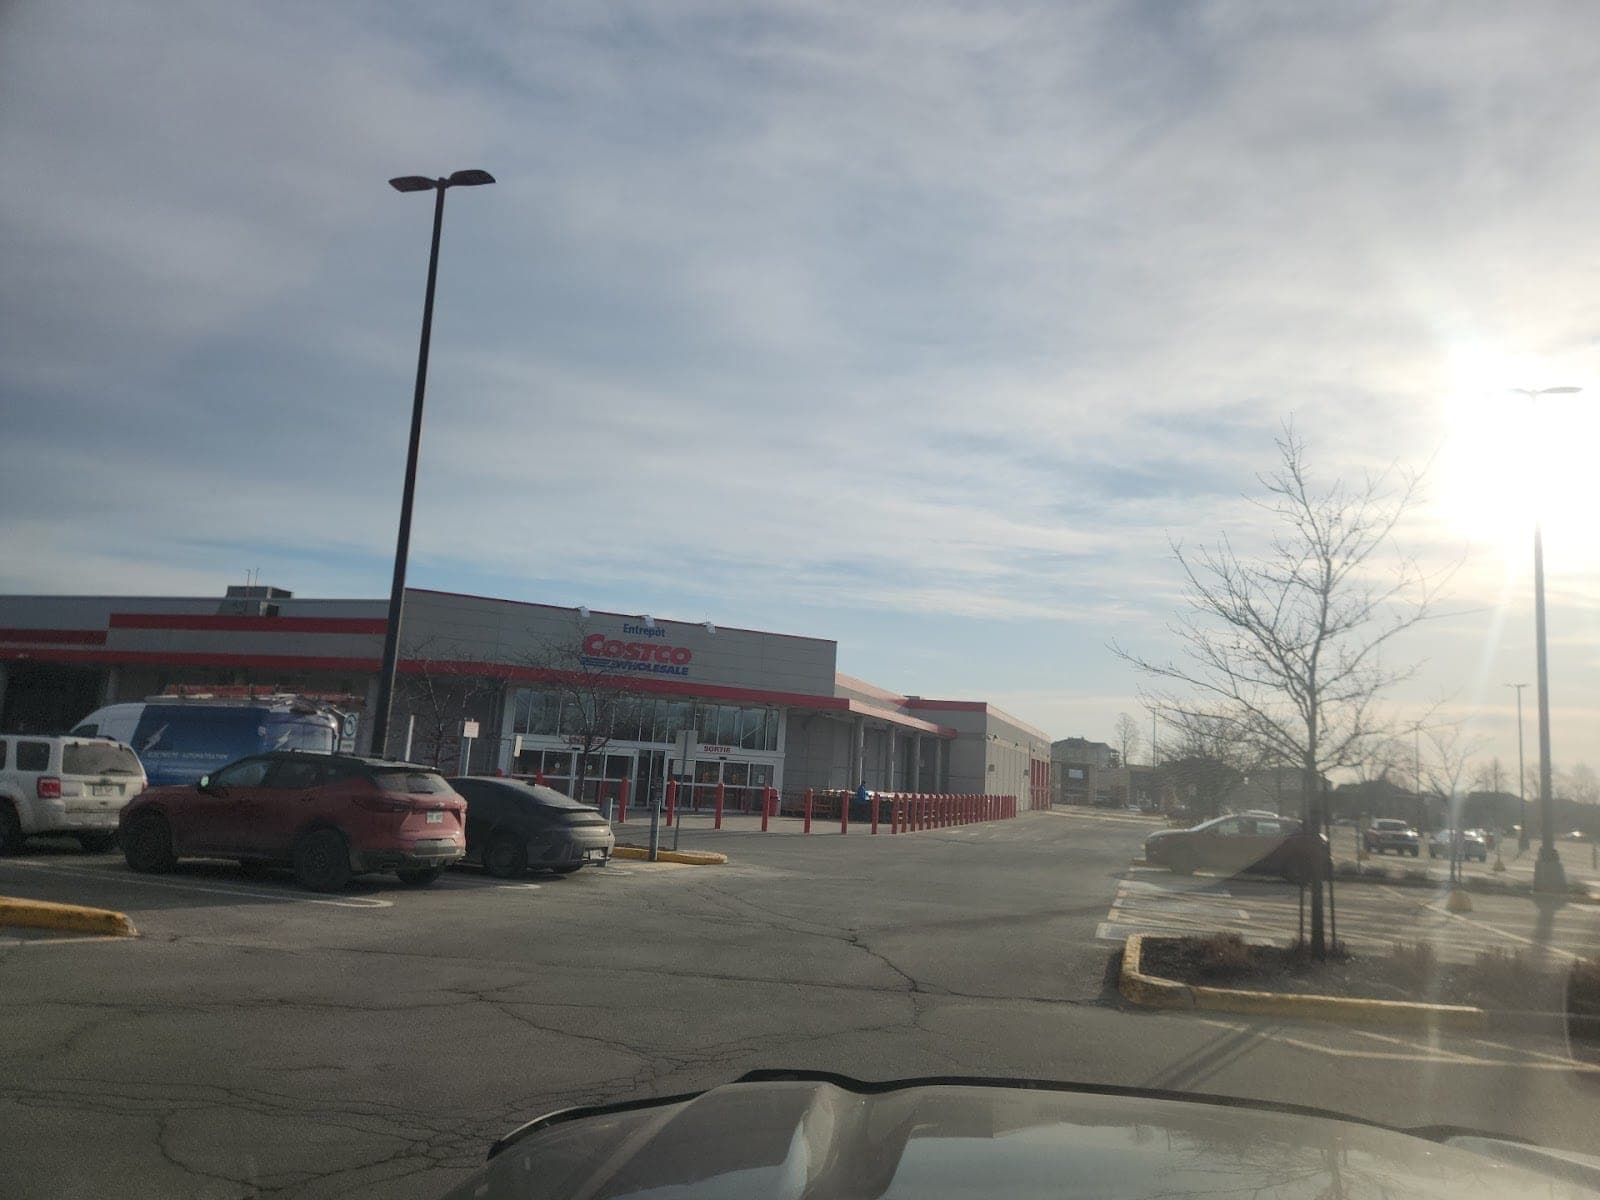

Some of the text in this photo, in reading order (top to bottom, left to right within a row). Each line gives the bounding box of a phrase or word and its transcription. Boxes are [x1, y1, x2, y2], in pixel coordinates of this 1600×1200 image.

[623, 623, 665, 638] Entrepôt
[615, 660, 689, 675] WHOLESALE
[703, 745, 731, 753] SORTIE
